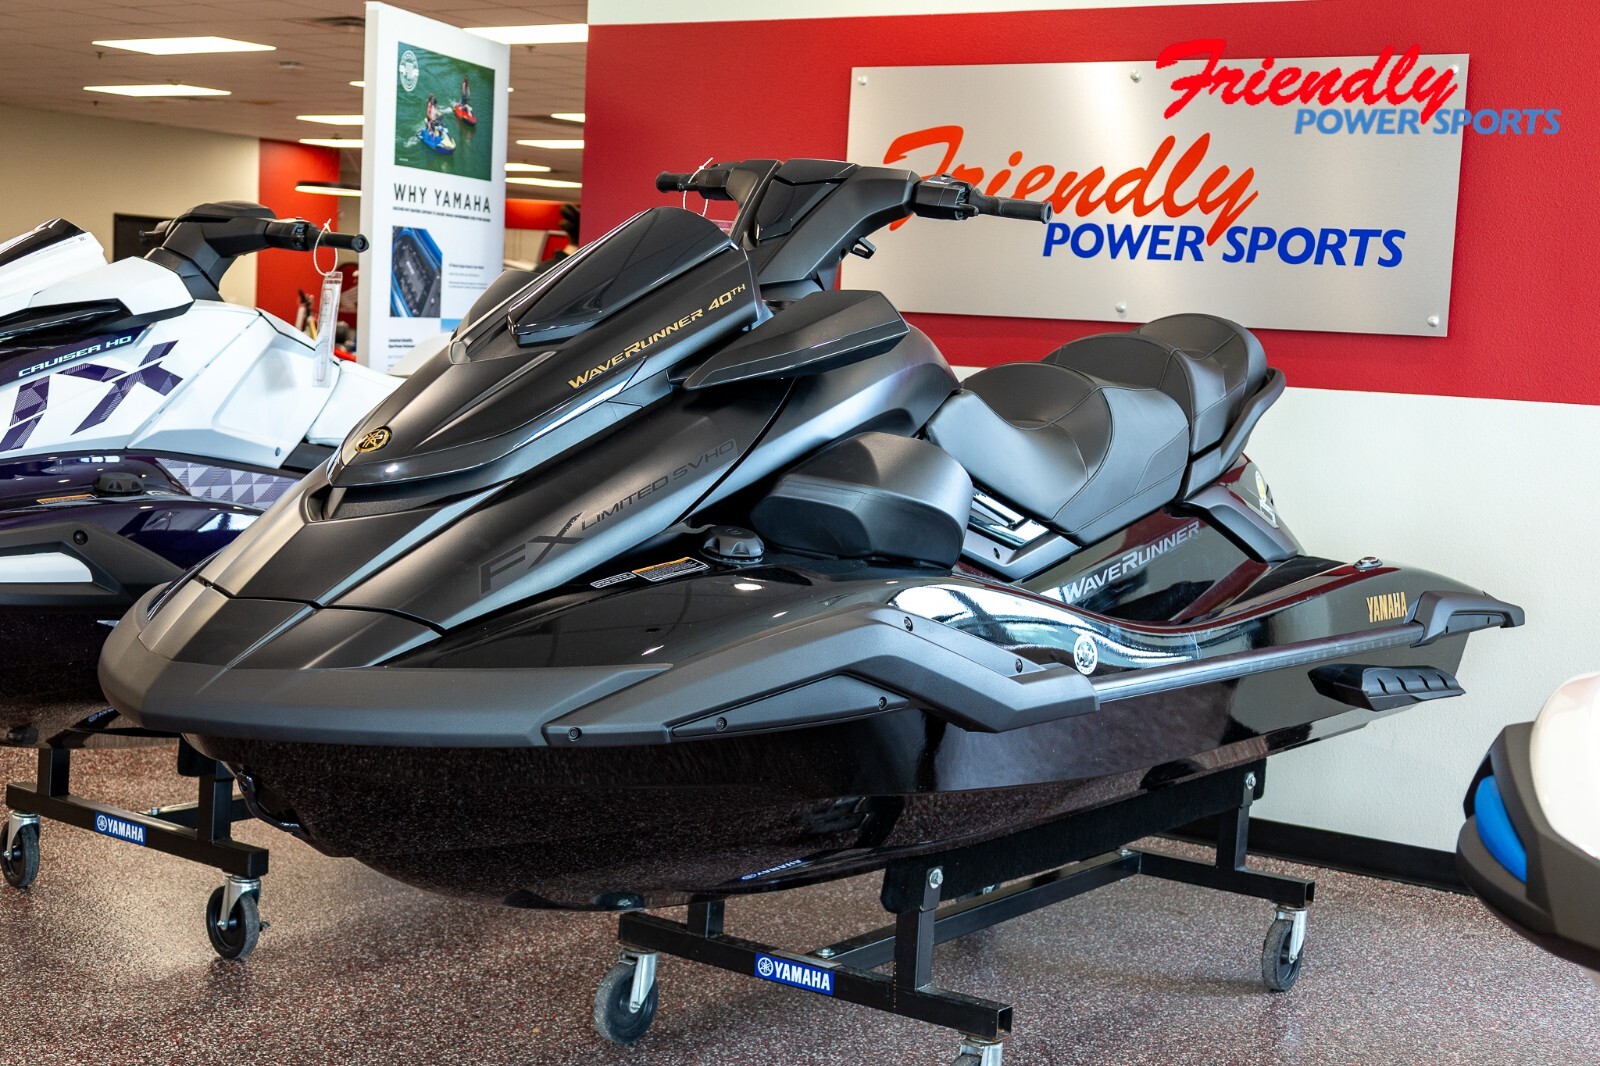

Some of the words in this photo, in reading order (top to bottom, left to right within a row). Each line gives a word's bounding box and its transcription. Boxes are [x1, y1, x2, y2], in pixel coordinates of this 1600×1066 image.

[393, 182, 427, 204] WHY
[434, 188, 491, 213] YAMAHA
[1042, 222, 1205, 262] POWER
[1222, 226, 1406, 267] SPORTS
[18, 345, 101, 377] CRUISER
[105, 335, 132, 349] HO
[479, 511, 585, 596] FX
[581, 475, 669, 531] LIMITED
[673, 438, 735, 481] SVHO
[1365, 591, 1408, 623] YAMAHA
[107, 818, 144, 843] YAMAHA
[774, 960, 831, 991] YAMAHA
